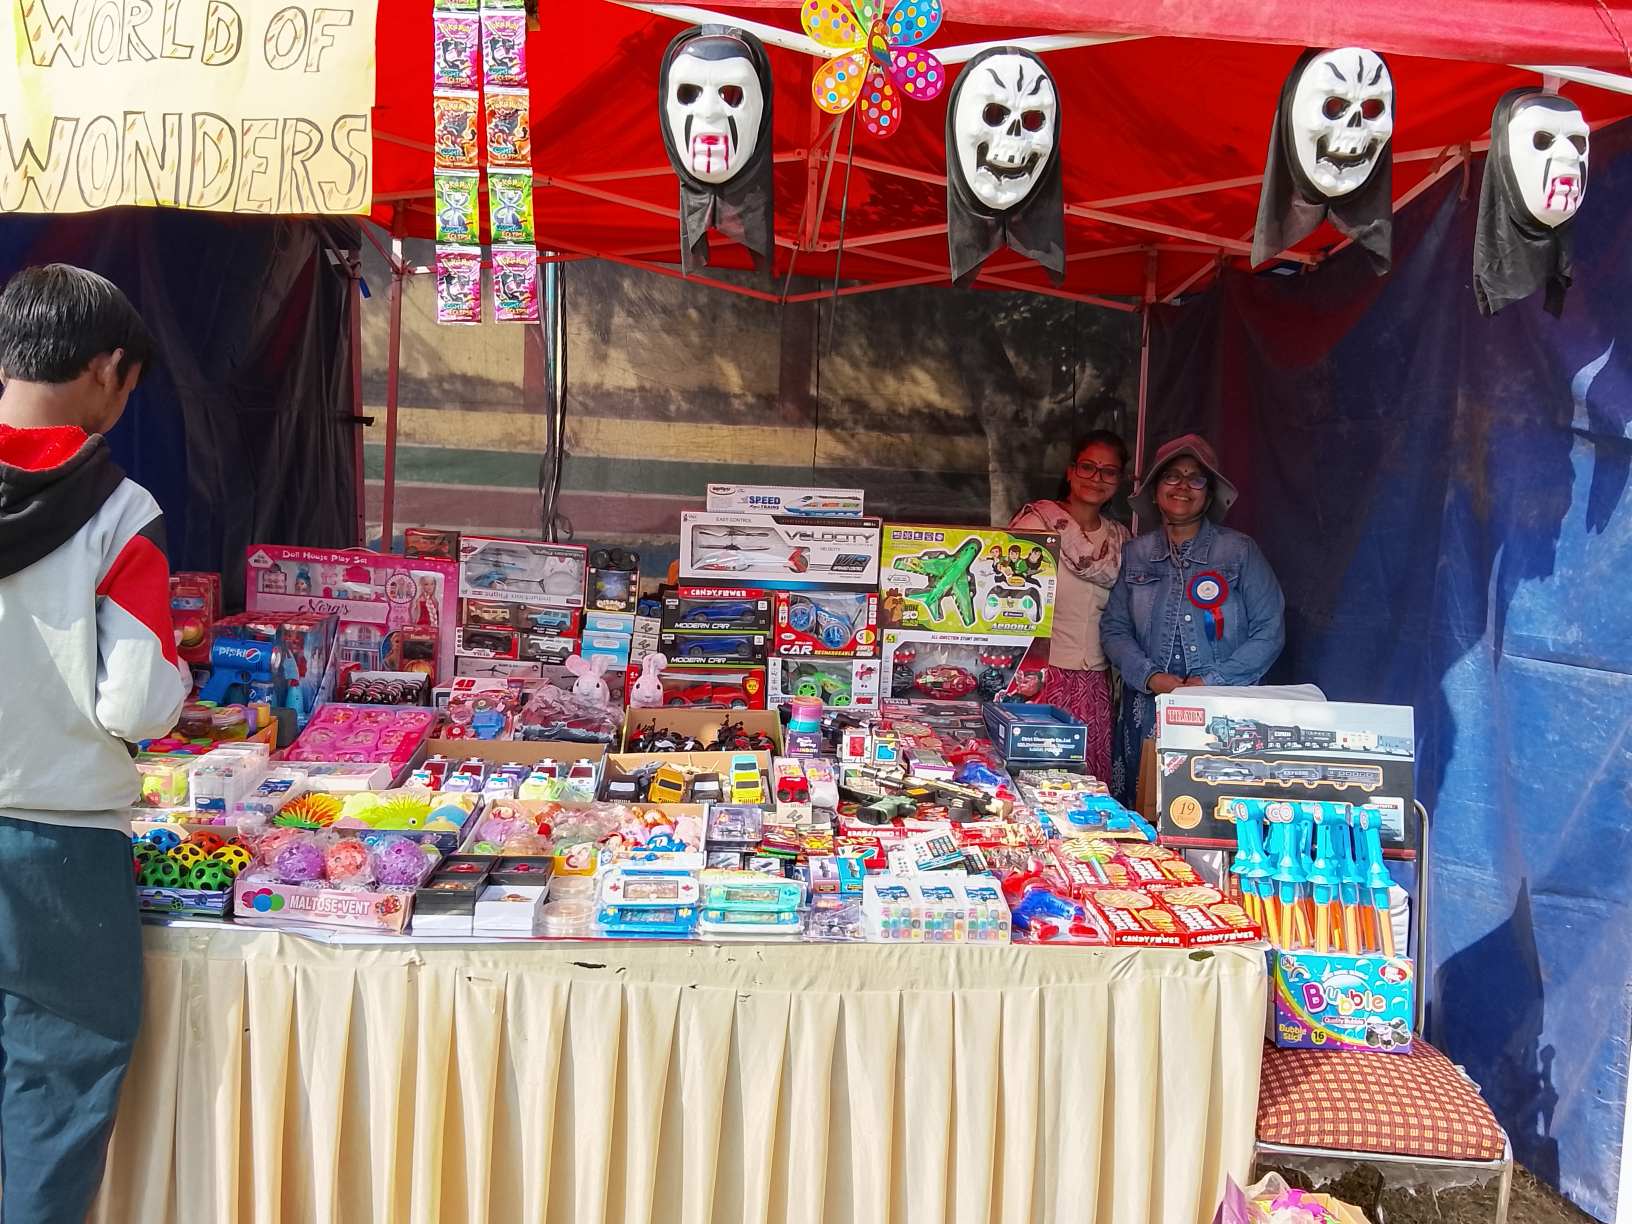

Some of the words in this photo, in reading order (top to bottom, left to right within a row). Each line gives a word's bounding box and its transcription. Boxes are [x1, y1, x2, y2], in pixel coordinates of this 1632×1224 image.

[20, 0, 242, 67] WORLD
[264, 4, 354, 73] OF
[0, 110, 368, 213] WONDERS
[749, 495, 781, 505] SPEED
[282, 550, 300, 558] Doll
[303, 551, 328, 561] House
[331, 554, 350, 563] Play
[353, 556, 367, 564] Set
[780, 644, 813, 655] CAR
[1180, 801, 1195, 815] 19
[837, 836, 878, 845] UNO
[1303, 982, 1386, 1016] Bubble
[1313, 1031, 1324, 1040] 16
